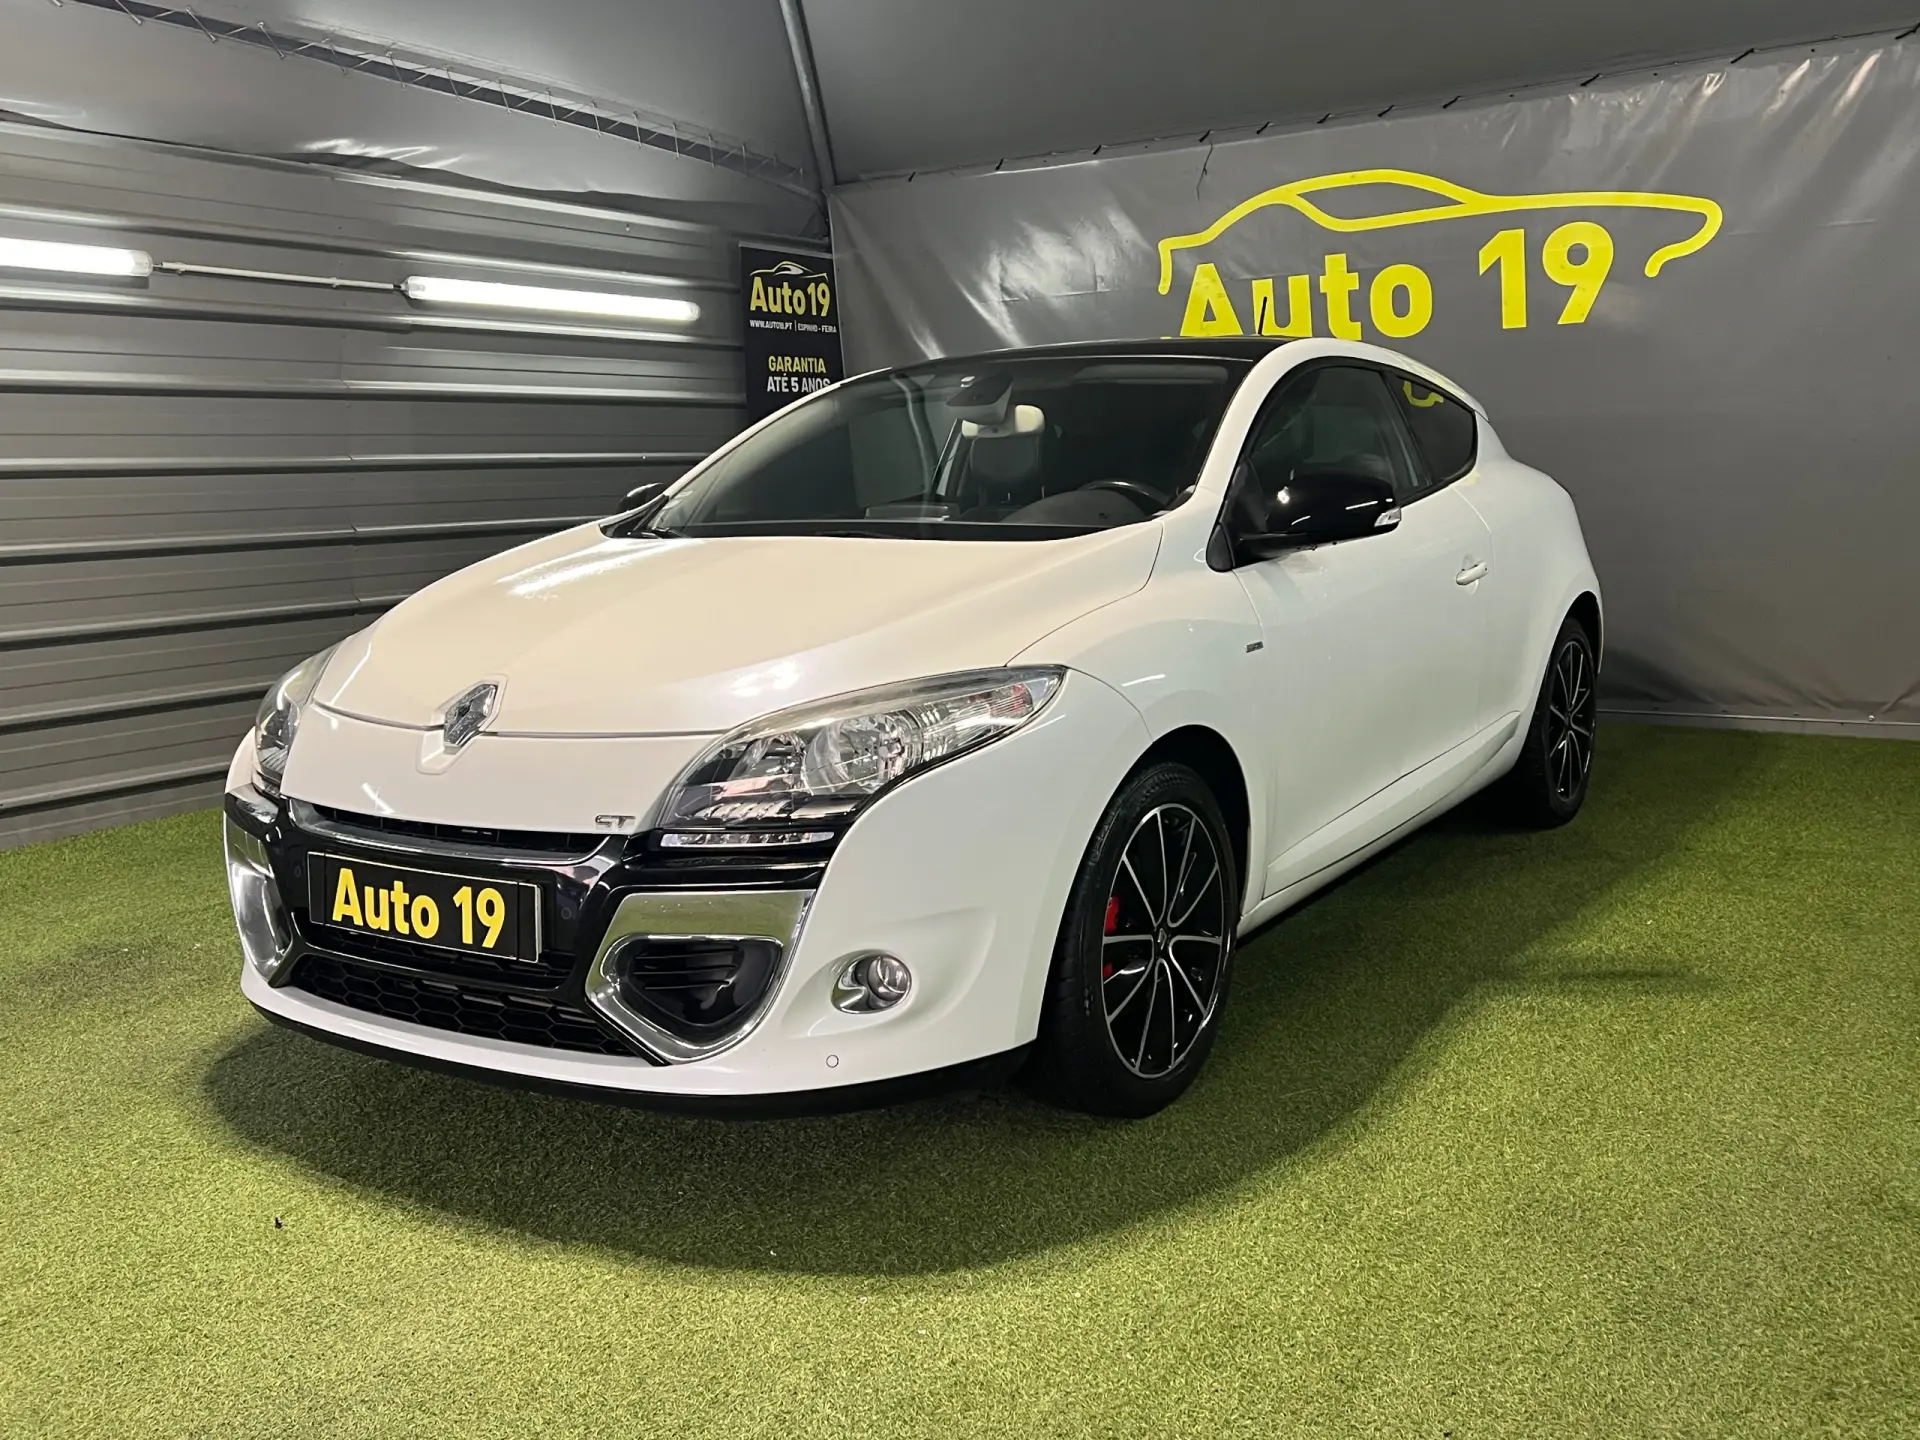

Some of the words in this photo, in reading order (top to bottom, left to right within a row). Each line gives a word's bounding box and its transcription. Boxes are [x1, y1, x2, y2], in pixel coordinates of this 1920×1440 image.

[1180, 253, 1433, 341] Auto
[1478, 221, 1615, 329] 19
[821, 324, 837, 333] FEIRA
[768, 355, 827, 373] GARANTIA
[766, 372, 789, 392] ATÉ
[790, 376, 799, 392] 5
[801, 377, 831, 392] ANOS
[332, 867, 440, 939] Auto
[452, 886, 506, 949] 19
